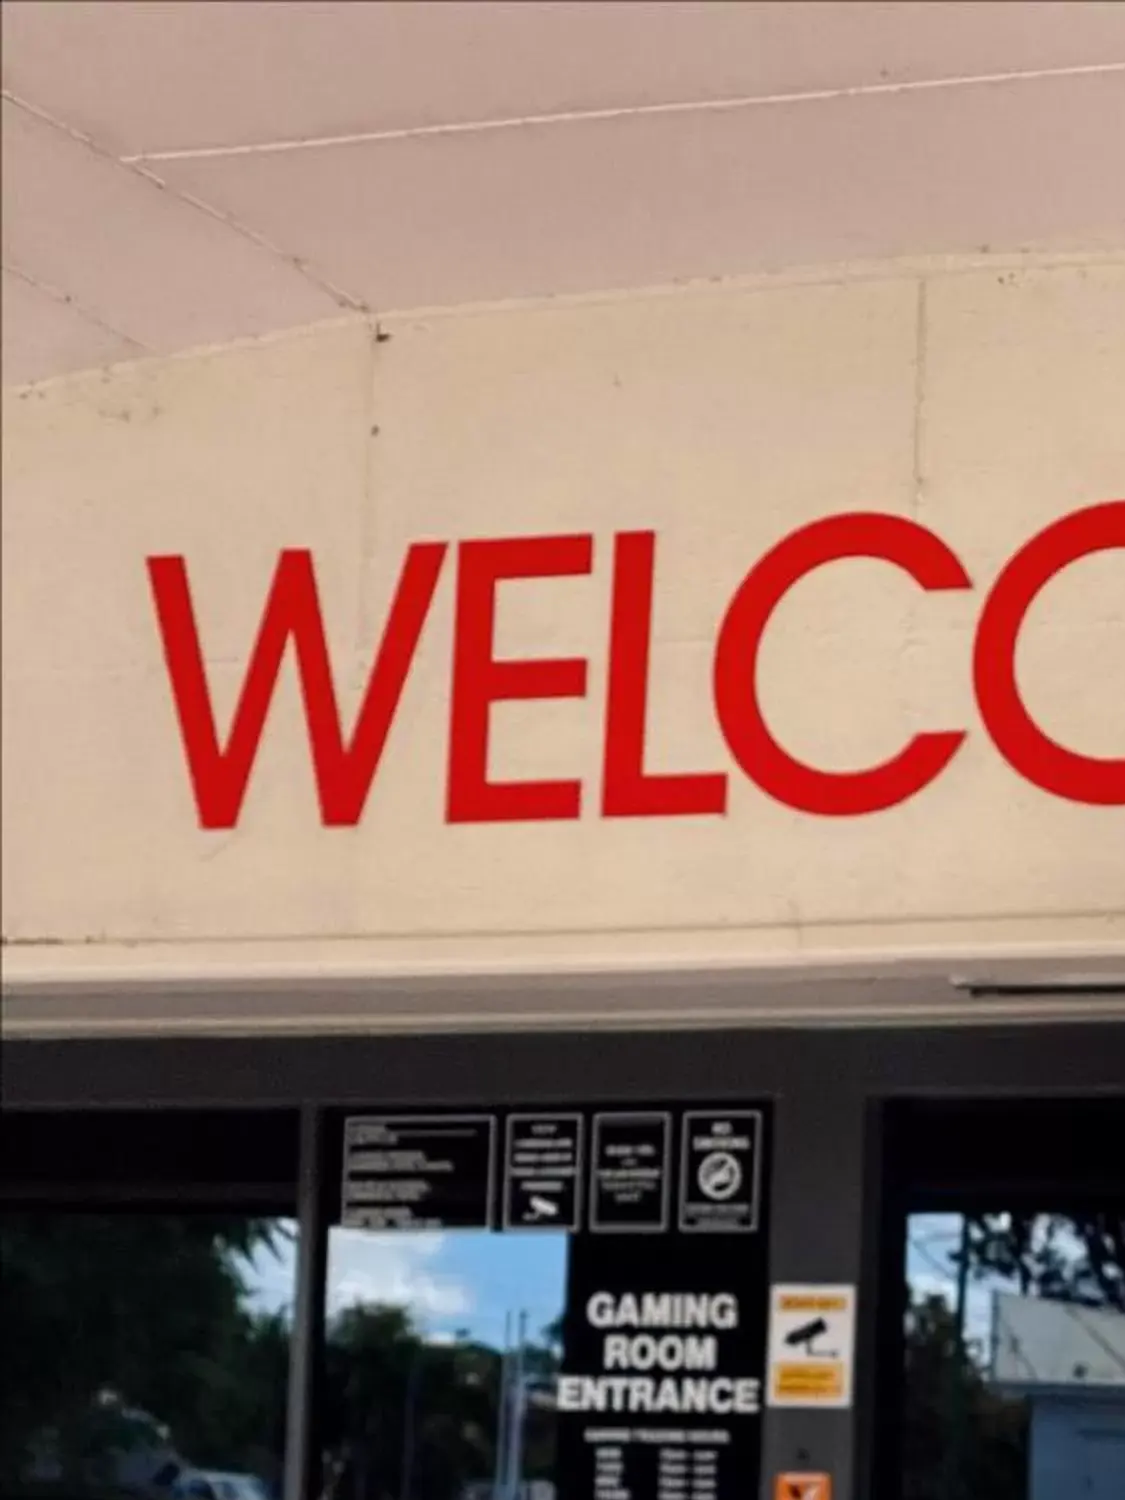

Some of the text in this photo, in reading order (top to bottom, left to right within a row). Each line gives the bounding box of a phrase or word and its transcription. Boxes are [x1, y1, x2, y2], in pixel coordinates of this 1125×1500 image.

[586, 1292, 738, 1330] GAMING
[603, 1334, 717, 1371] ROOM
[555, 1376, 760, 1414] ENTRANCE
